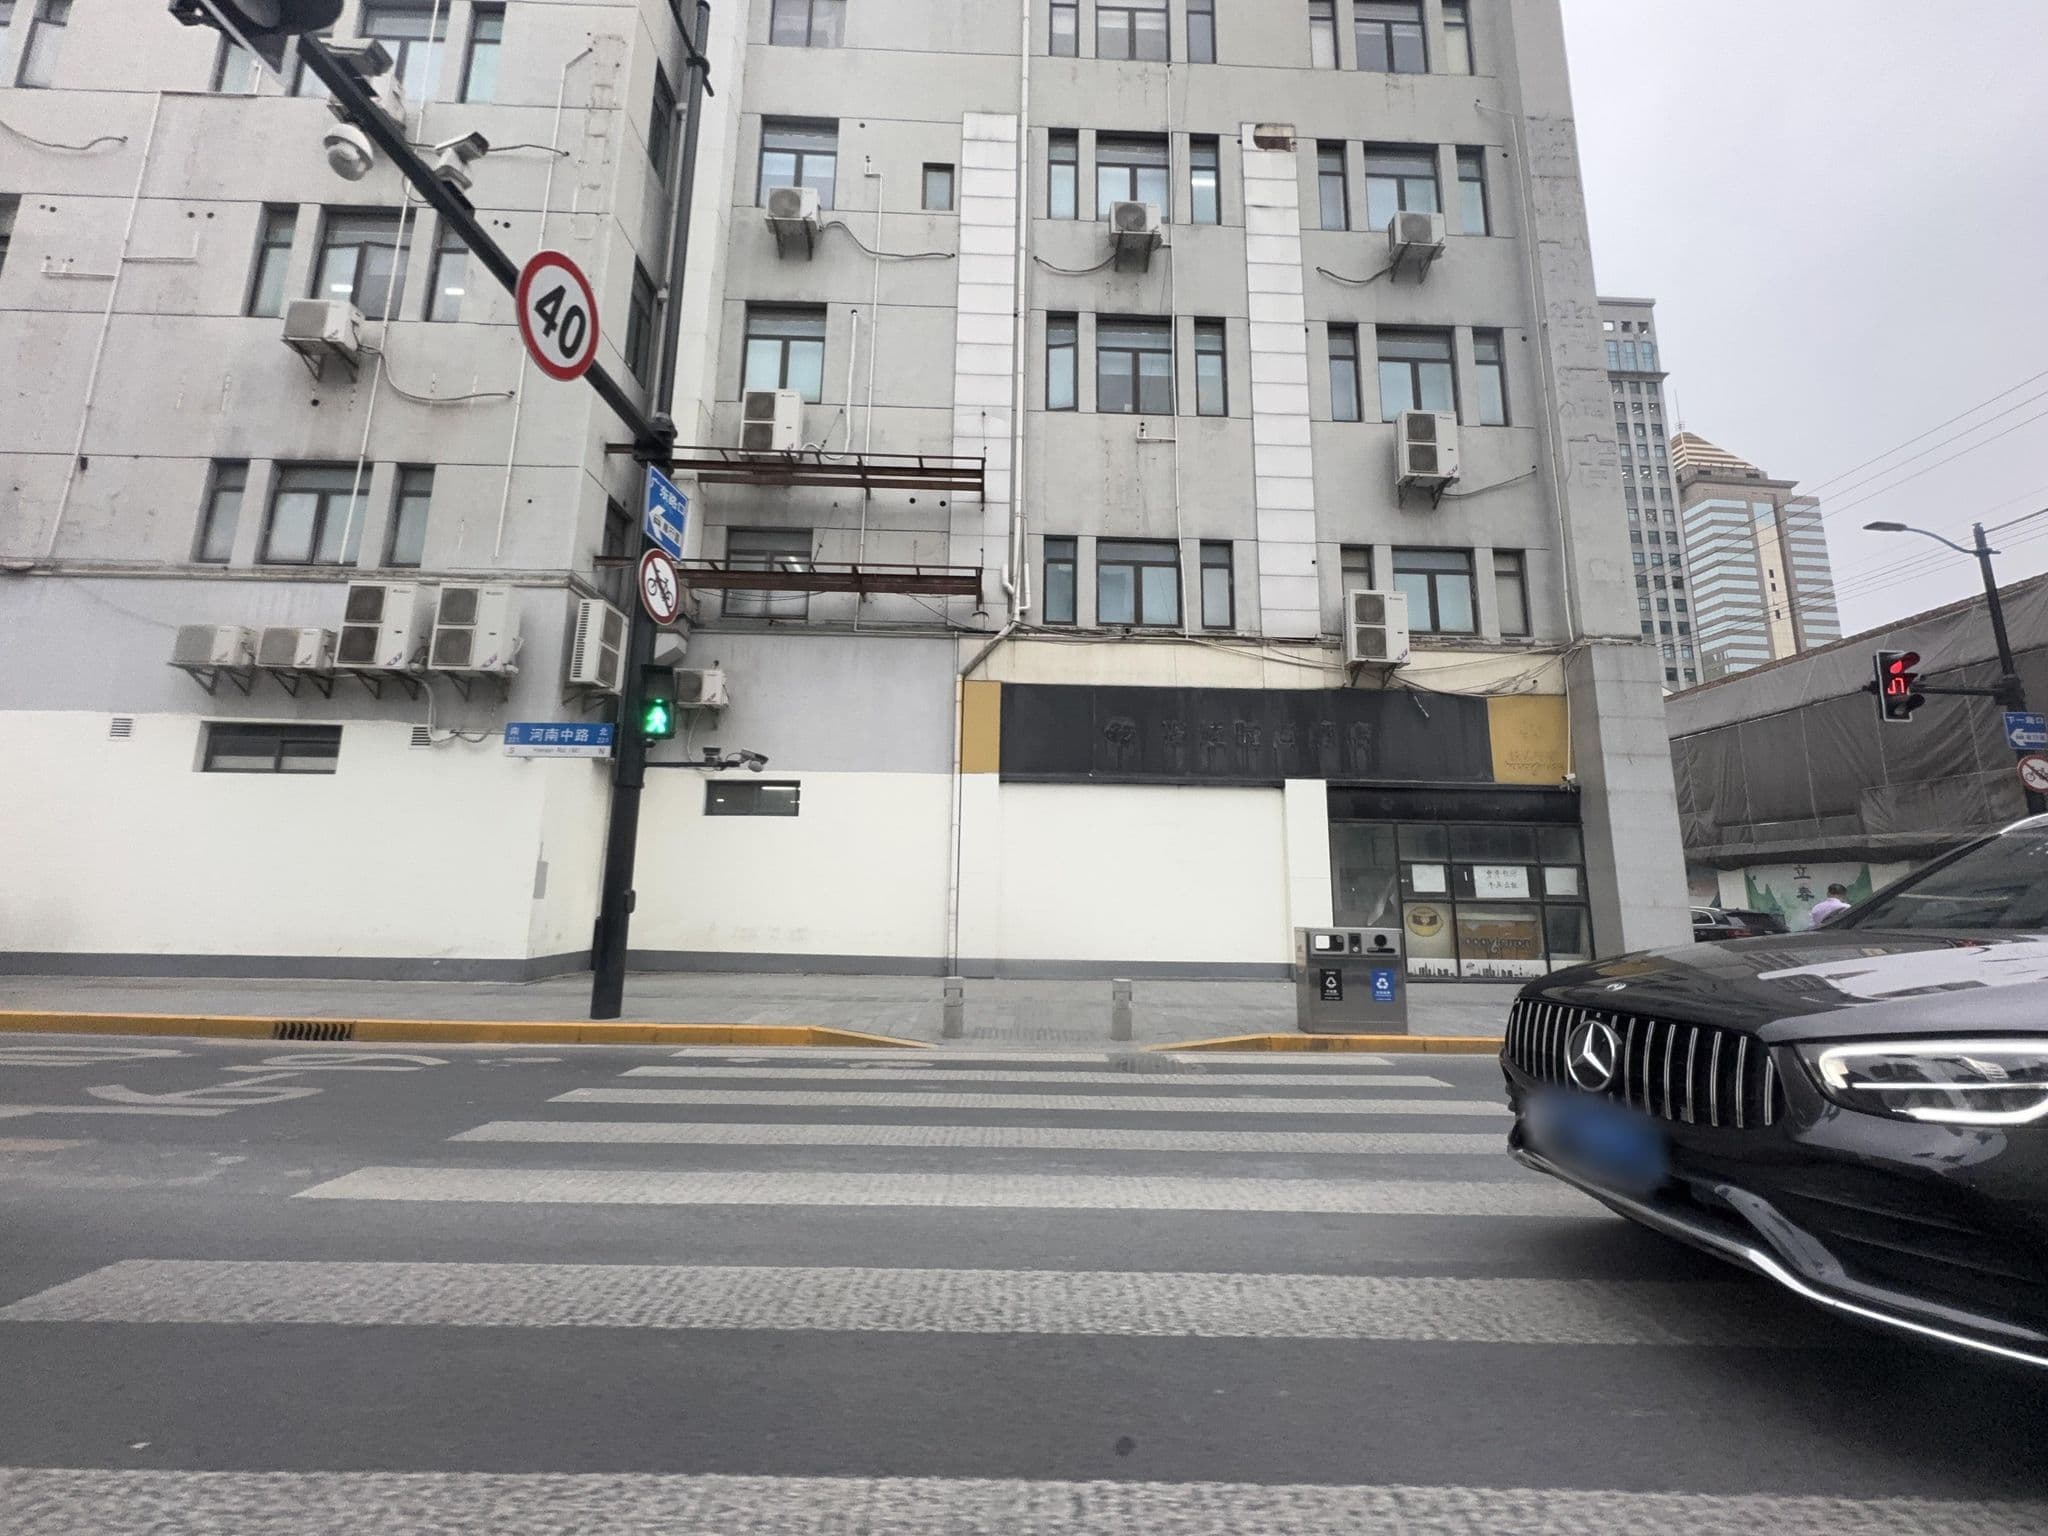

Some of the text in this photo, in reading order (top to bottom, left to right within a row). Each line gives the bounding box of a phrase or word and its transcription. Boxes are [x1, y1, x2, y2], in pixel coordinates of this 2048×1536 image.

[534, 285, 587, 359] 40
[529, 727, 589, 742] 河南中路
